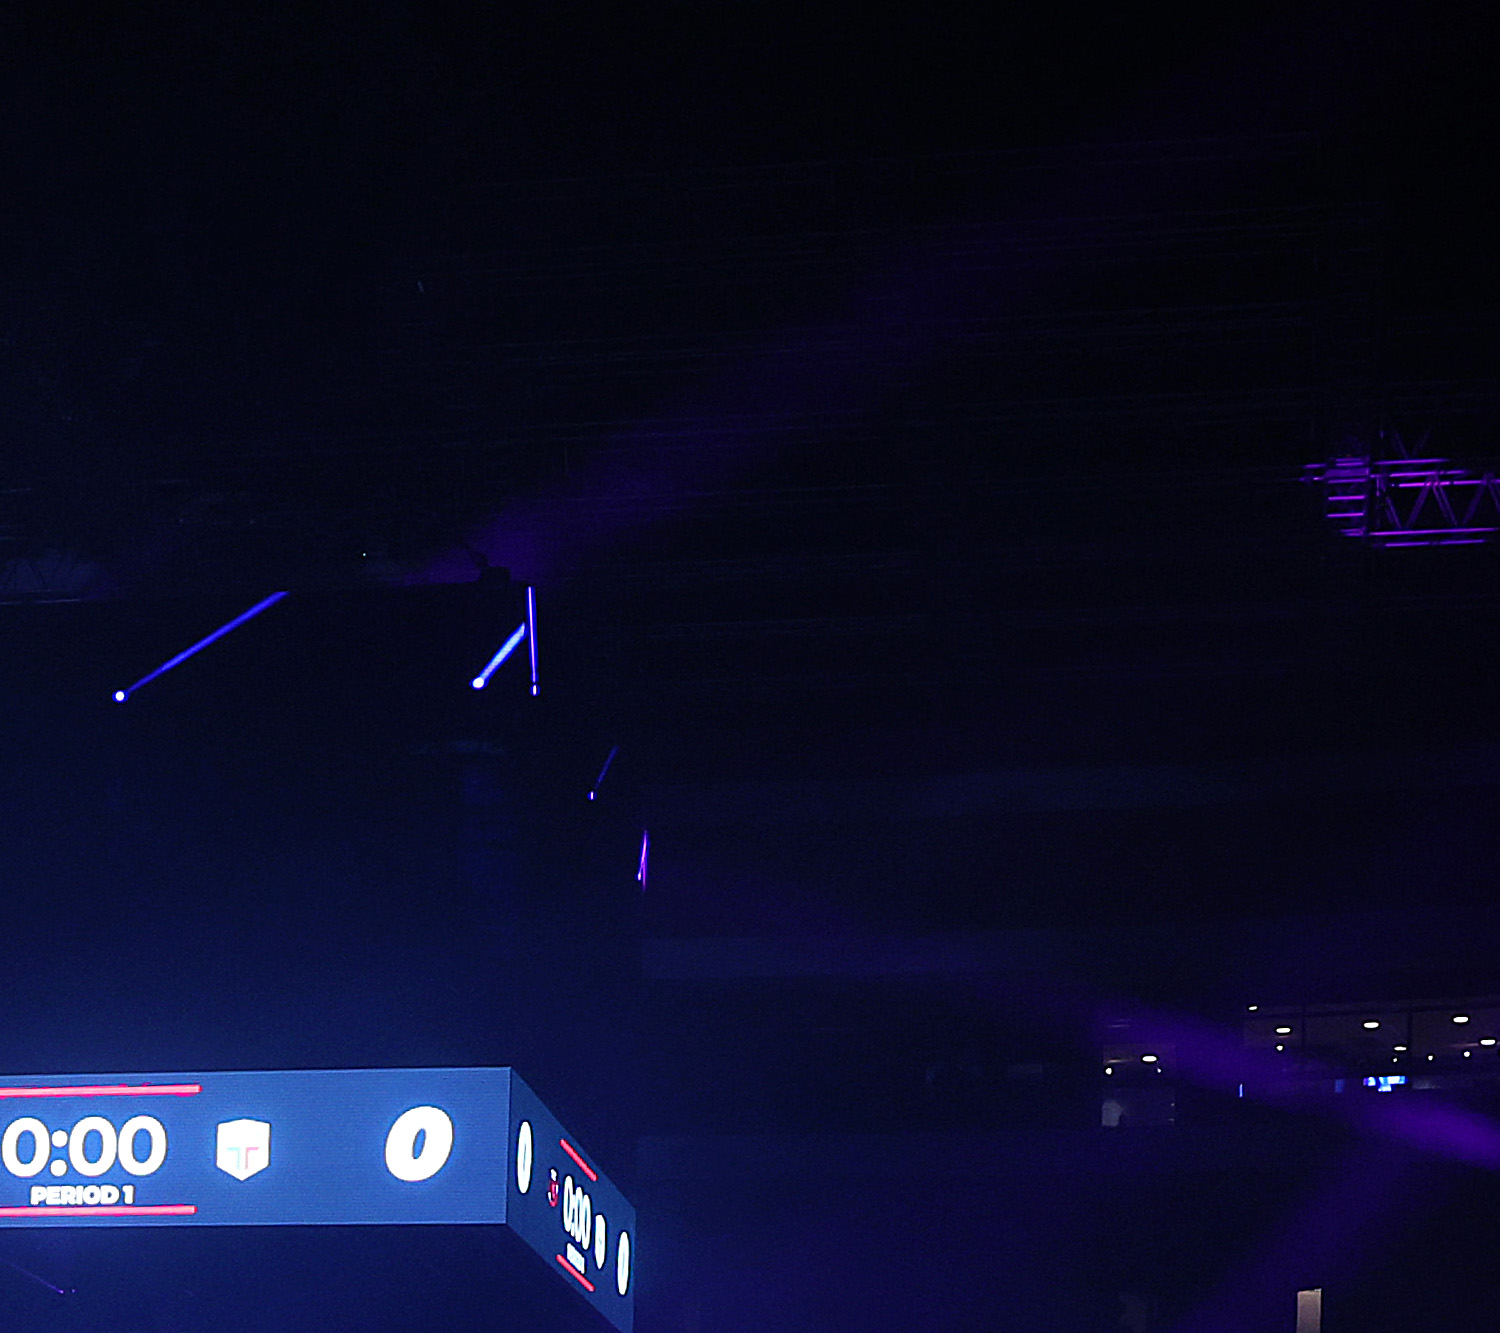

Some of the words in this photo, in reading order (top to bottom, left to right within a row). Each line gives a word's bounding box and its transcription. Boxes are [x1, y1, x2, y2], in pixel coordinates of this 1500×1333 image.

[0, 1114, 168, 1179] 0:00
[384, 1104, 454, 1183] 0
[29, 1184, 117, 1206] PERIOD
[122, 1184, 134, 1205] 1
